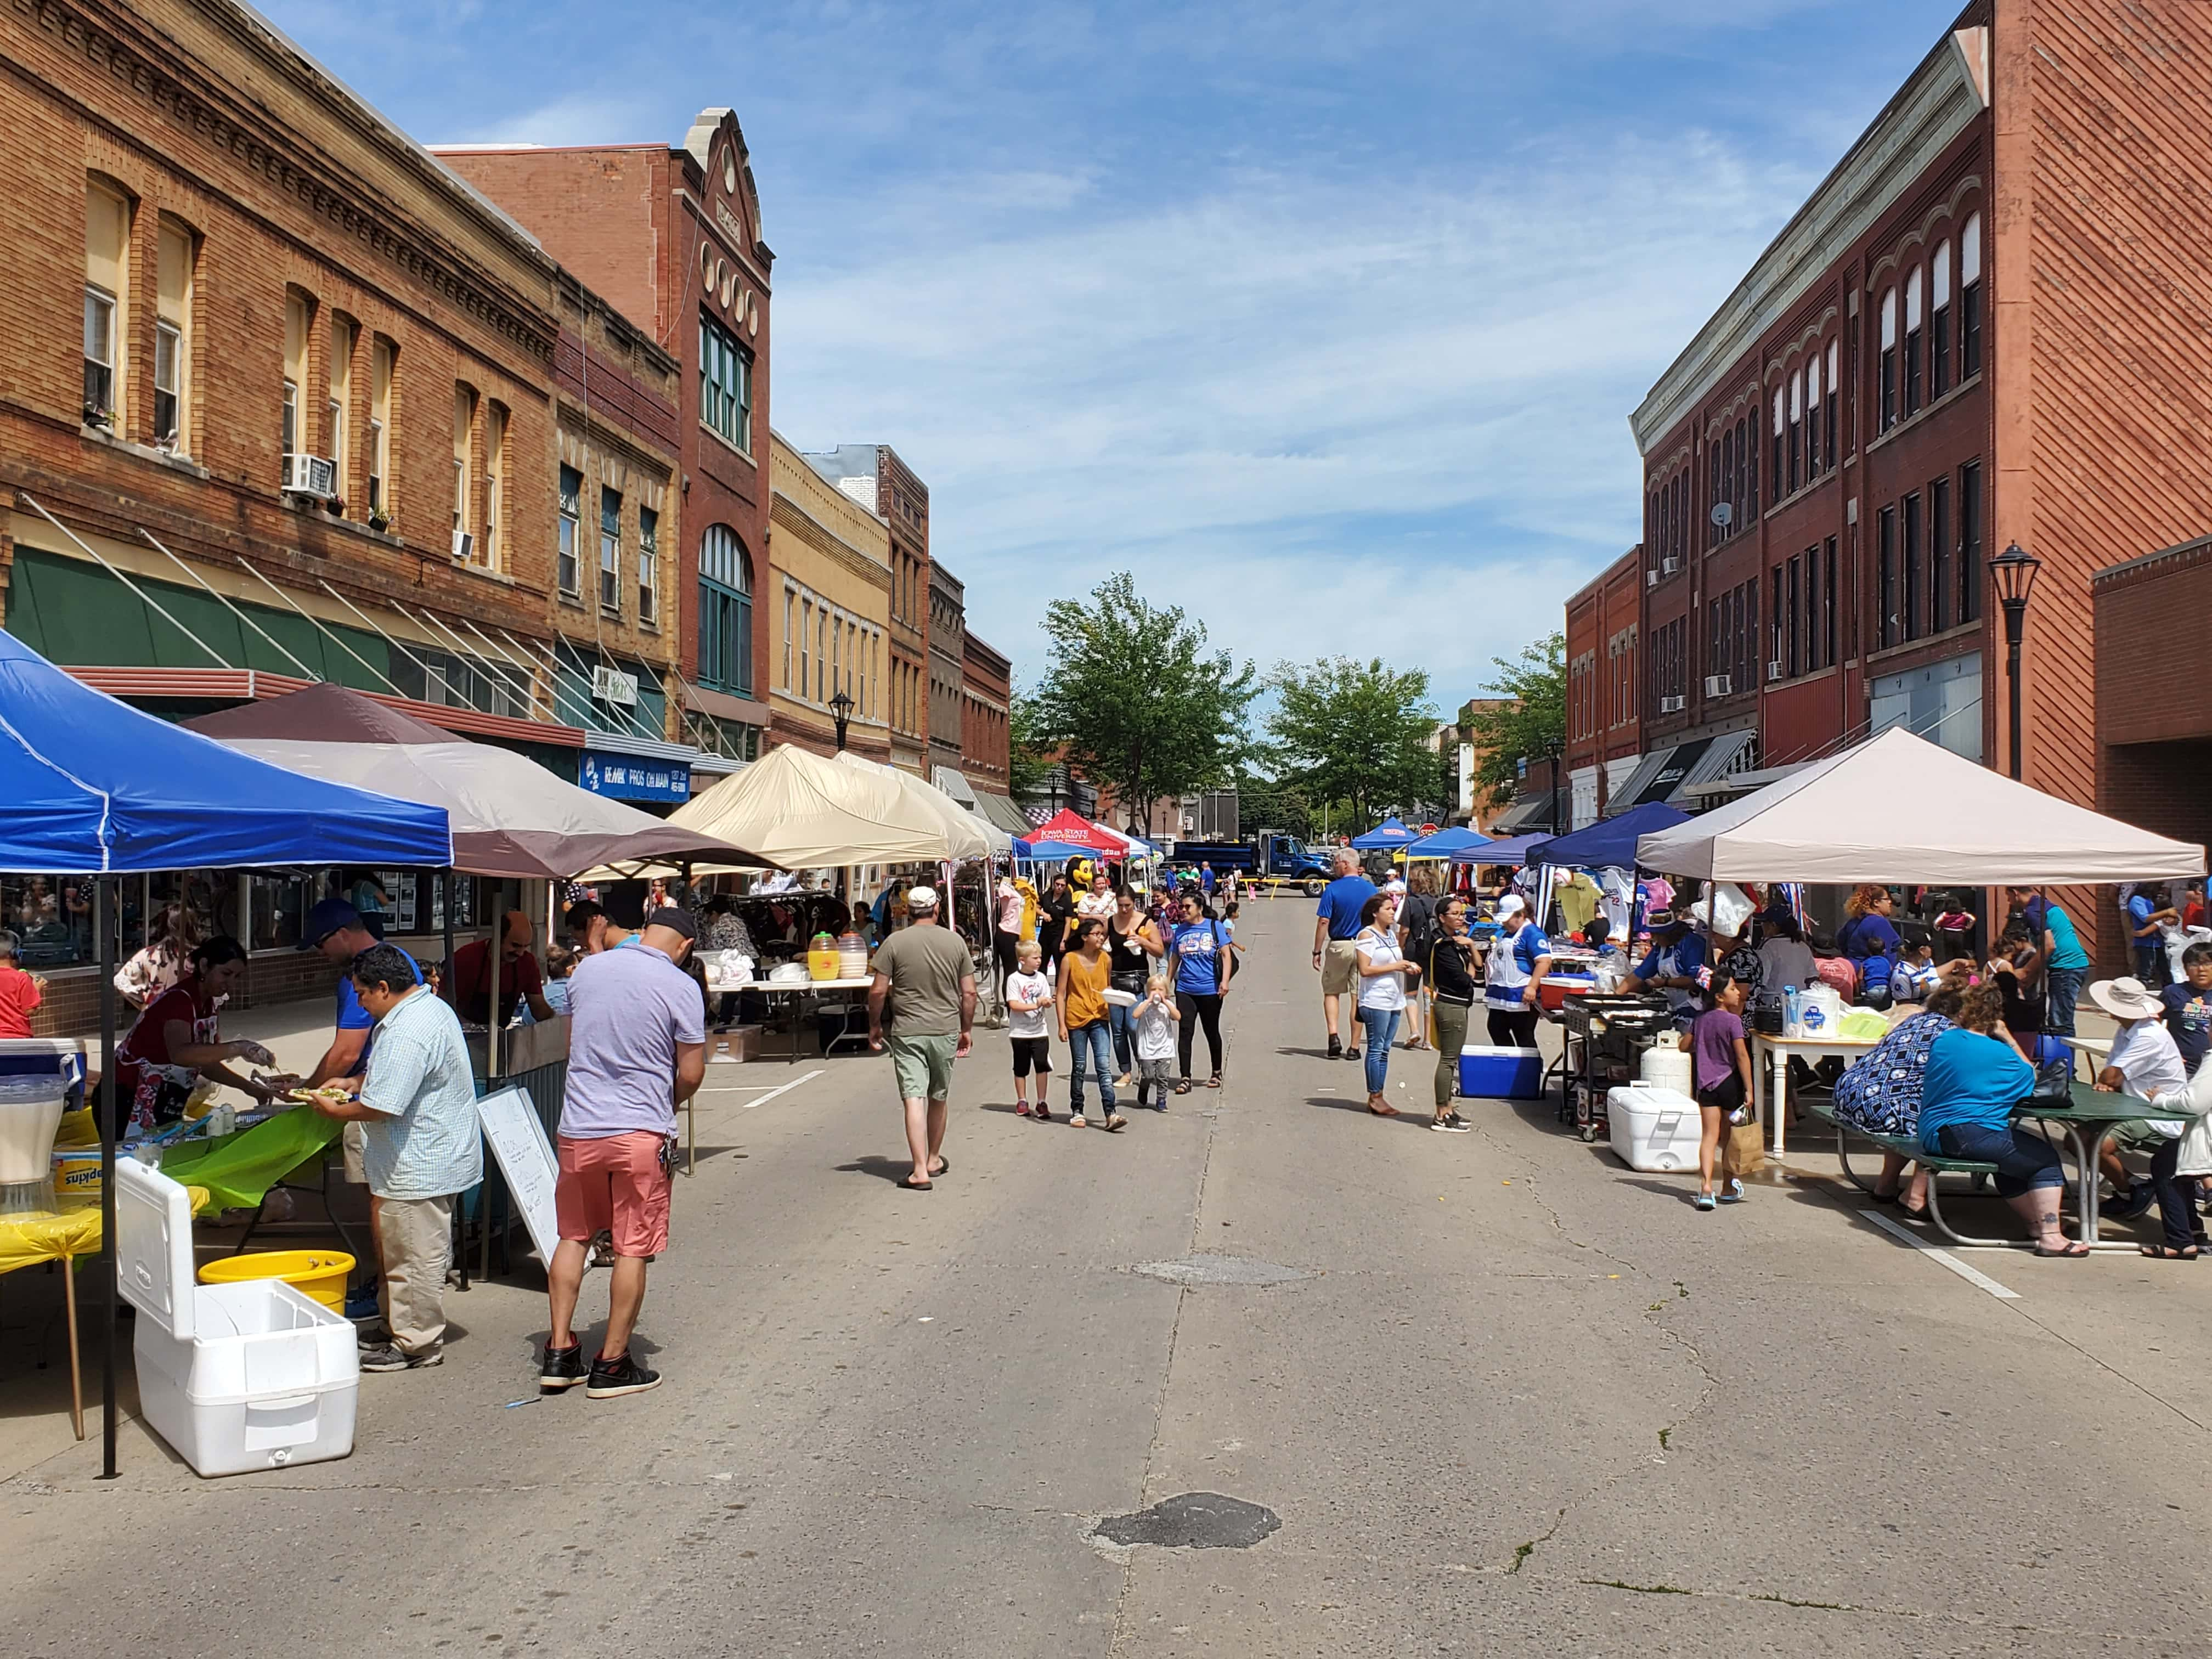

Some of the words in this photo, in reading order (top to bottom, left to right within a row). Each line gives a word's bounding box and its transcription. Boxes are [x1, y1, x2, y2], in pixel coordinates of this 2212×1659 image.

[629, 769, 645, 786] PROS
[646, 772, 655, 788] ON
[655, 772, 669, 788] MAIN
[65, 1167, 102, 1185] apkins
